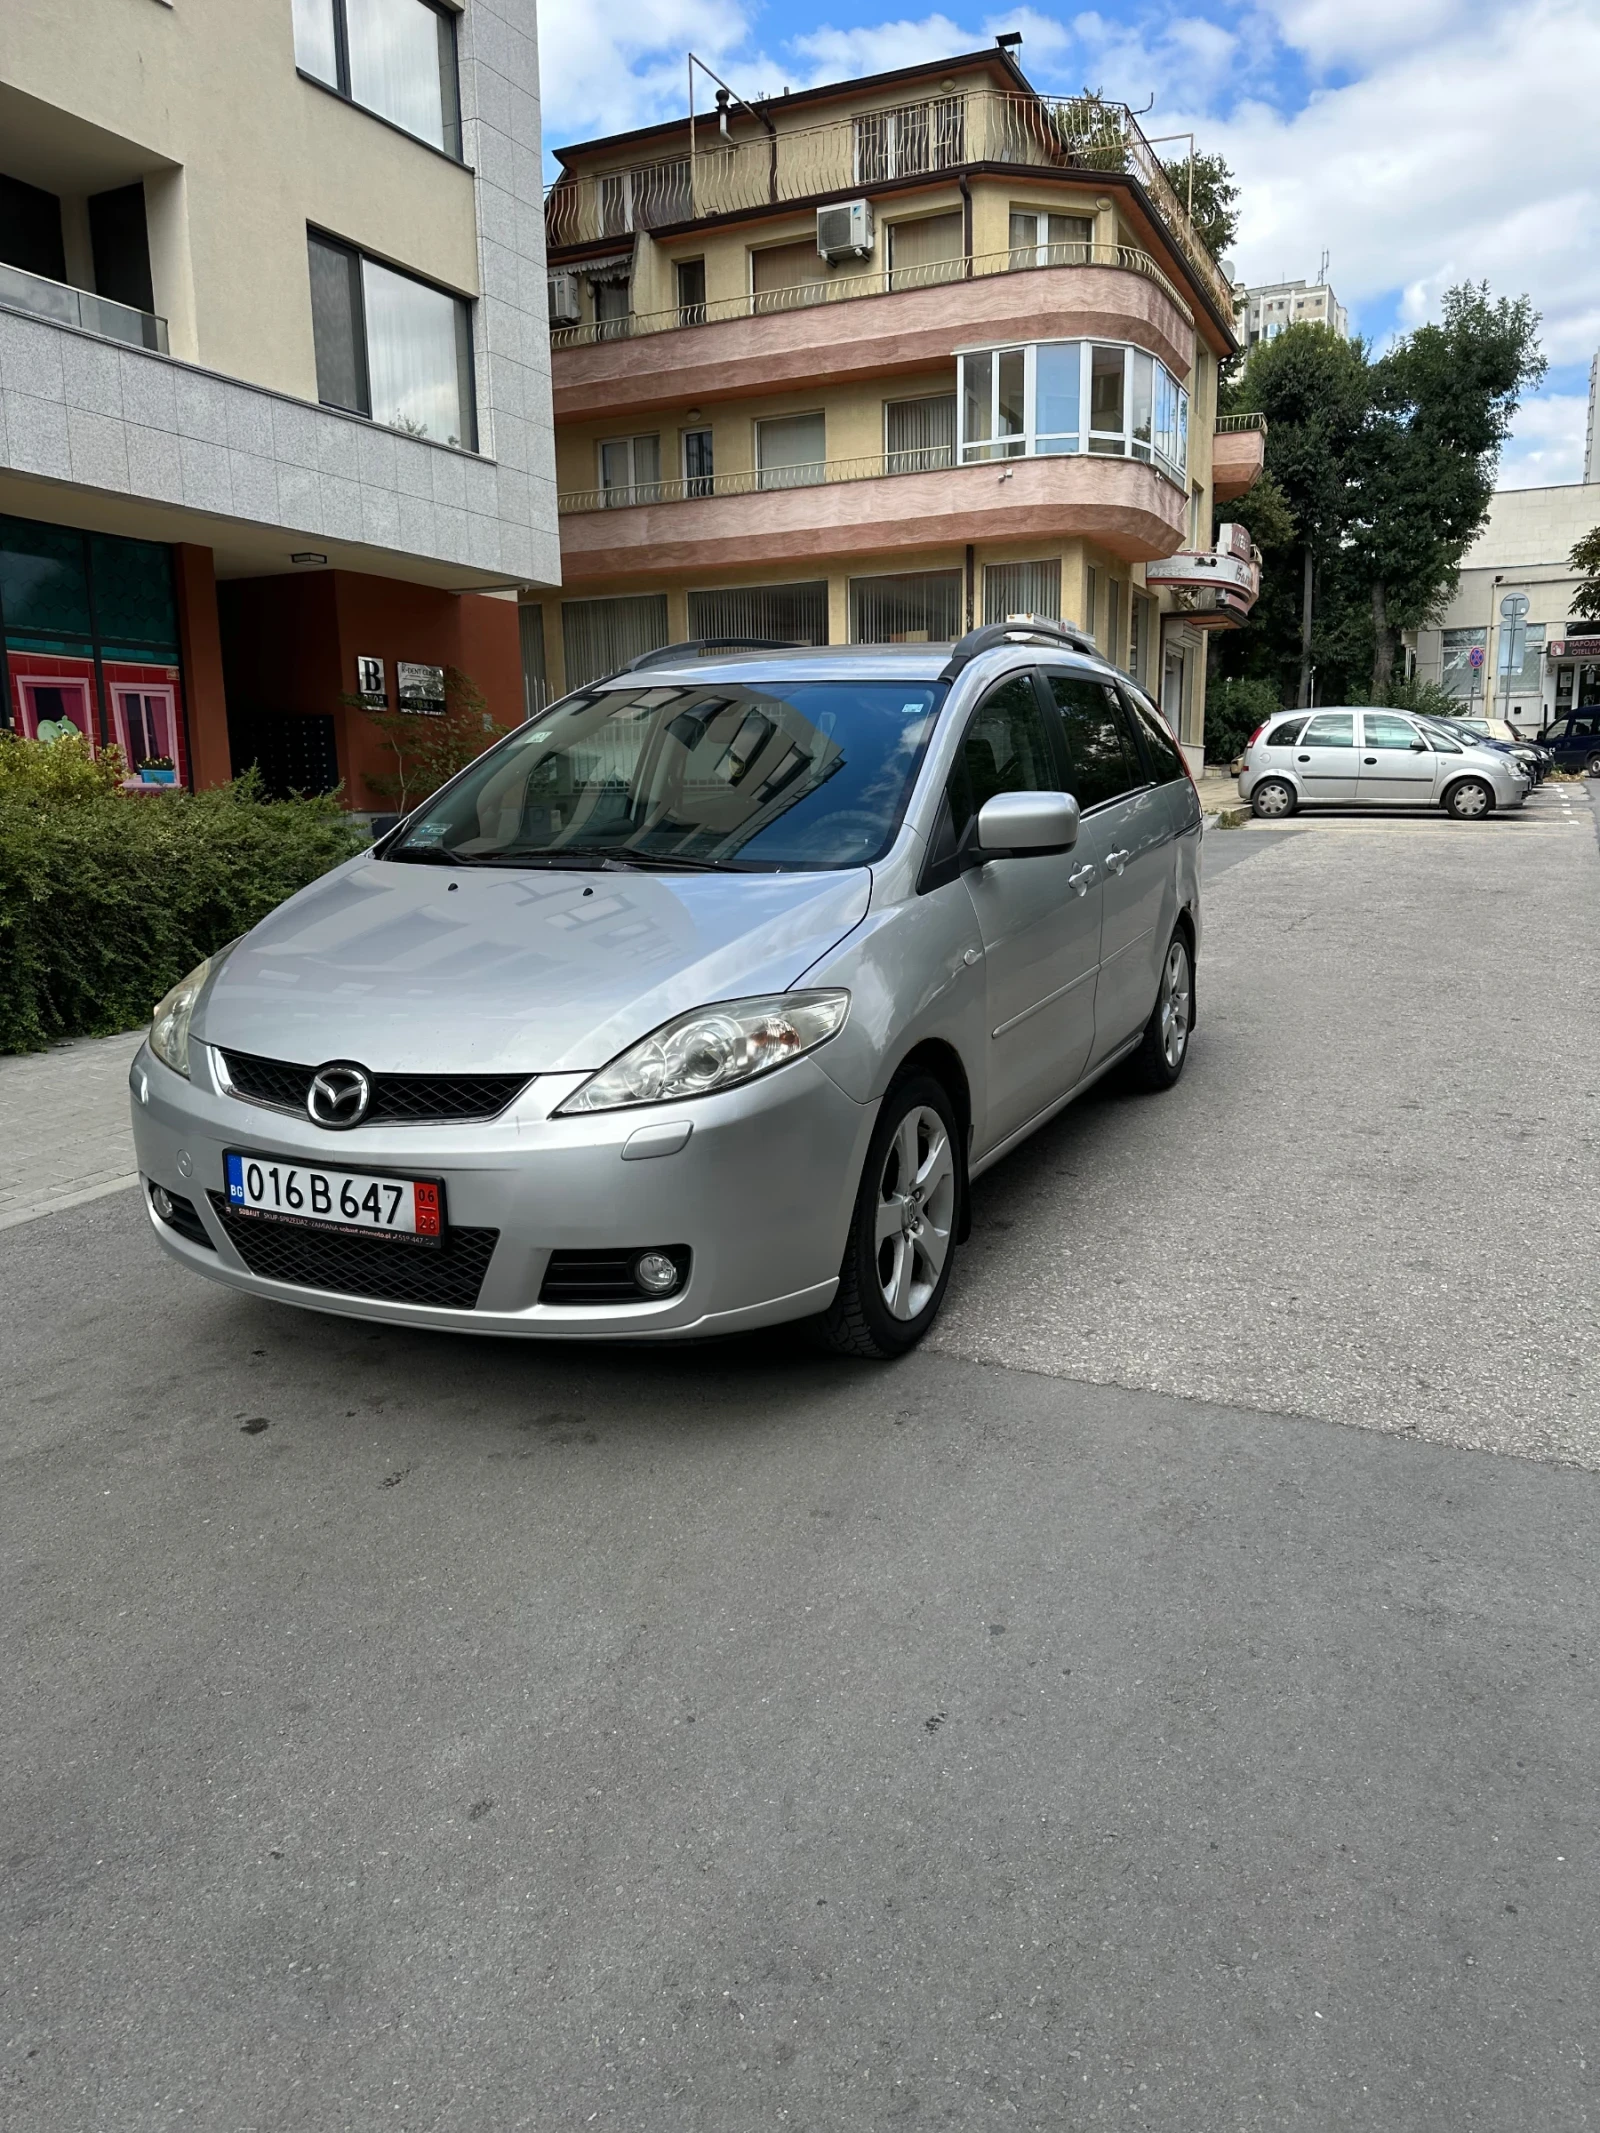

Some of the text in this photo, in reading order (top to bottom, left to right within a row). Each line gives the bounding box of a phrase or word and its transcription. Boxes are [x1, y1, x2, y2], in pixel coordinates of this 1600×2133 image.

[230, 1184, 244, 1198] BG
[418, 1188, 436, 1203] 06
[238, 1207, 261, 1218] SOBAUT
[419, 1215, 437, 1230] 28
